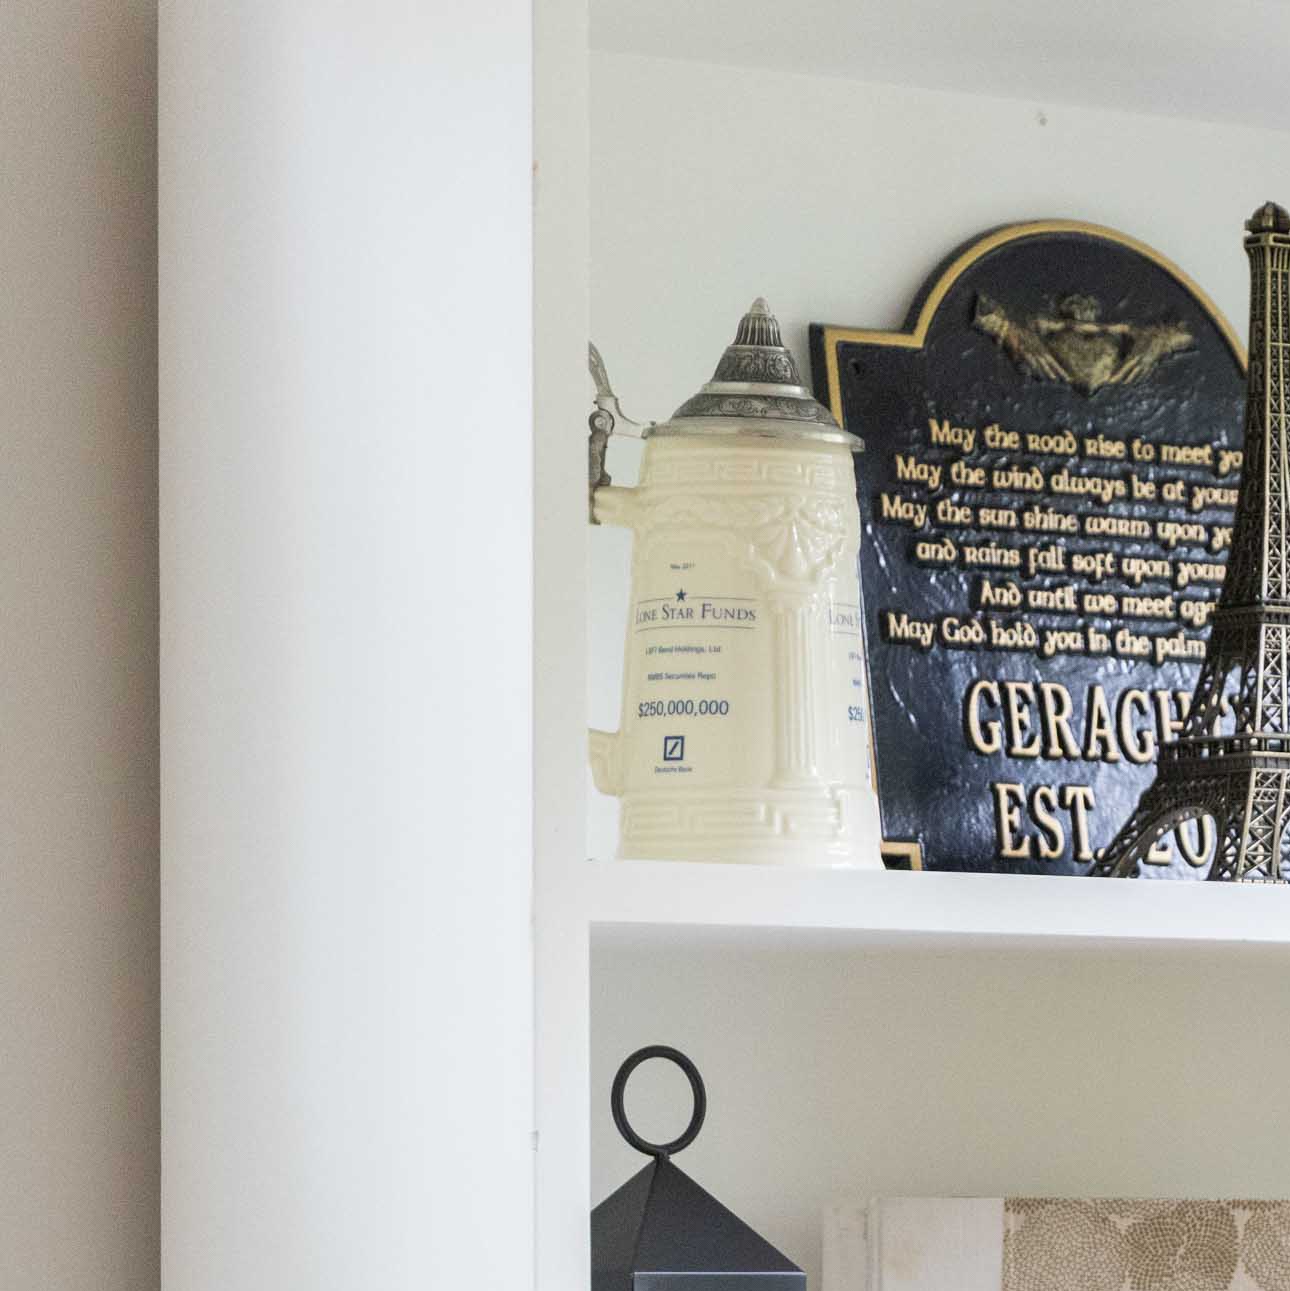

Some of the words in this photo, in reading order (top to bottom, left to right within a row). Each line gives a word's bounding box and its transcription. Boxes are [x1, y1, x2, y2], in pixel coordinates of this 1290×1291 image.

[928, 419, 976, 451] May
[983, 425, 1020, 450] the
[1028, 431, 1077, 454] road
[1084, 435, 1124, 460] rise
[1132, 442, 1155, 461] to
[1162, 444, 1213, 464] meet
[895, 454, 942, 487] May
[950, 459, 986, 485] the
[993, 464, 1043, 489] wind
[1051, 468, 1126, 502] always
[1132, 475, 1156, 498] be
[1162, 481, 1185, 501] at
[882, 494, 927, 527] May
[936, 499, 971, 523] the
[979, 504, 1017, 526] sun
[1024, 507, 1078, 531] shine
[1085, 515, 1150, 537] warm
[1157, 520, 1206, 546] upon
[916, 539, 956, 560] and
[964, 544, 1021, 567] rains
[1028, 546, 1065, 576] fall
[1072, 553, 1115, 578] soft
[1122, 557, 1171, 585] upon
[662, 603, 694, 621] STAR
[701, 602, 757, 621] FUNDS
[980, 580, 1022, 607] And
[1028, 586, 1077, 610] until
[1083, 593, 1118, 613] we
[1123, 595, 1176, 618] meet
[887, 612, 935, 646] May
[942, 617, 985, 642] God
[991, 618, 1037, 646] hold
[1044, 633, 1084, 657] you
[1089, 628, 1111, 651] in
[1116, 632, 1149, 654] the
[1156, 631, 1206, 664] palm
[638, 699, 730, 718] $250,000,000
[968, 681, 1240, 764] GERAGH
[996, 783, 1105, 860] EST.
